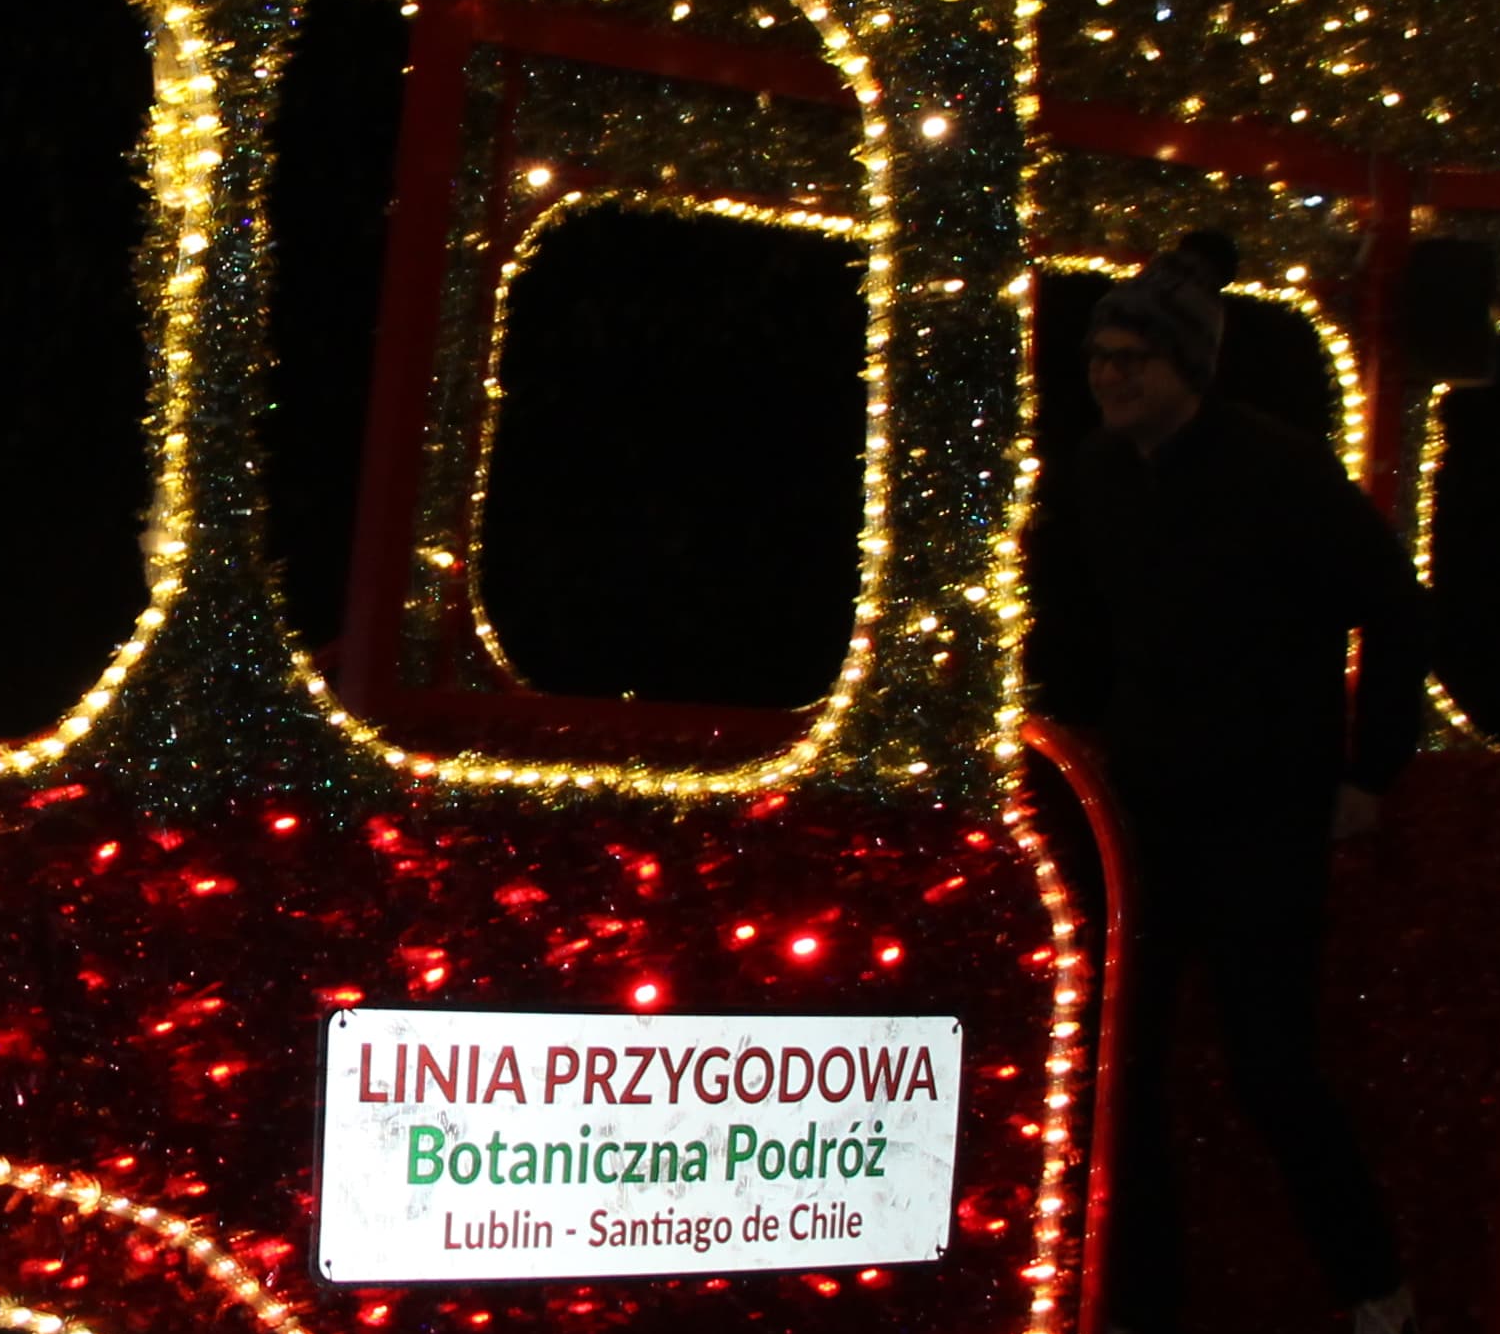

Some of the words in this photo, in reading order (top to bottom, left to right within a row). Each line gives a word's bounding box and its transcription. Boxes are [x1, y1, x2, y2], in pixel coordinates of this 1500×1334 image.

[358, 1043, 527, 1104] LINIA
[544, 1045, 938, 1105] PRZYGODOWA
[406, 1124, 708, 1186] Botaniczna
[725, 1123, 888, 1182] Podróż
[444, 1210, 552, 1251] Lublin
[588, 1208, 731, 1253] Santiago
[742, 1207, 779, 1242] de
[789, 1202, 863, 1240] Chile
